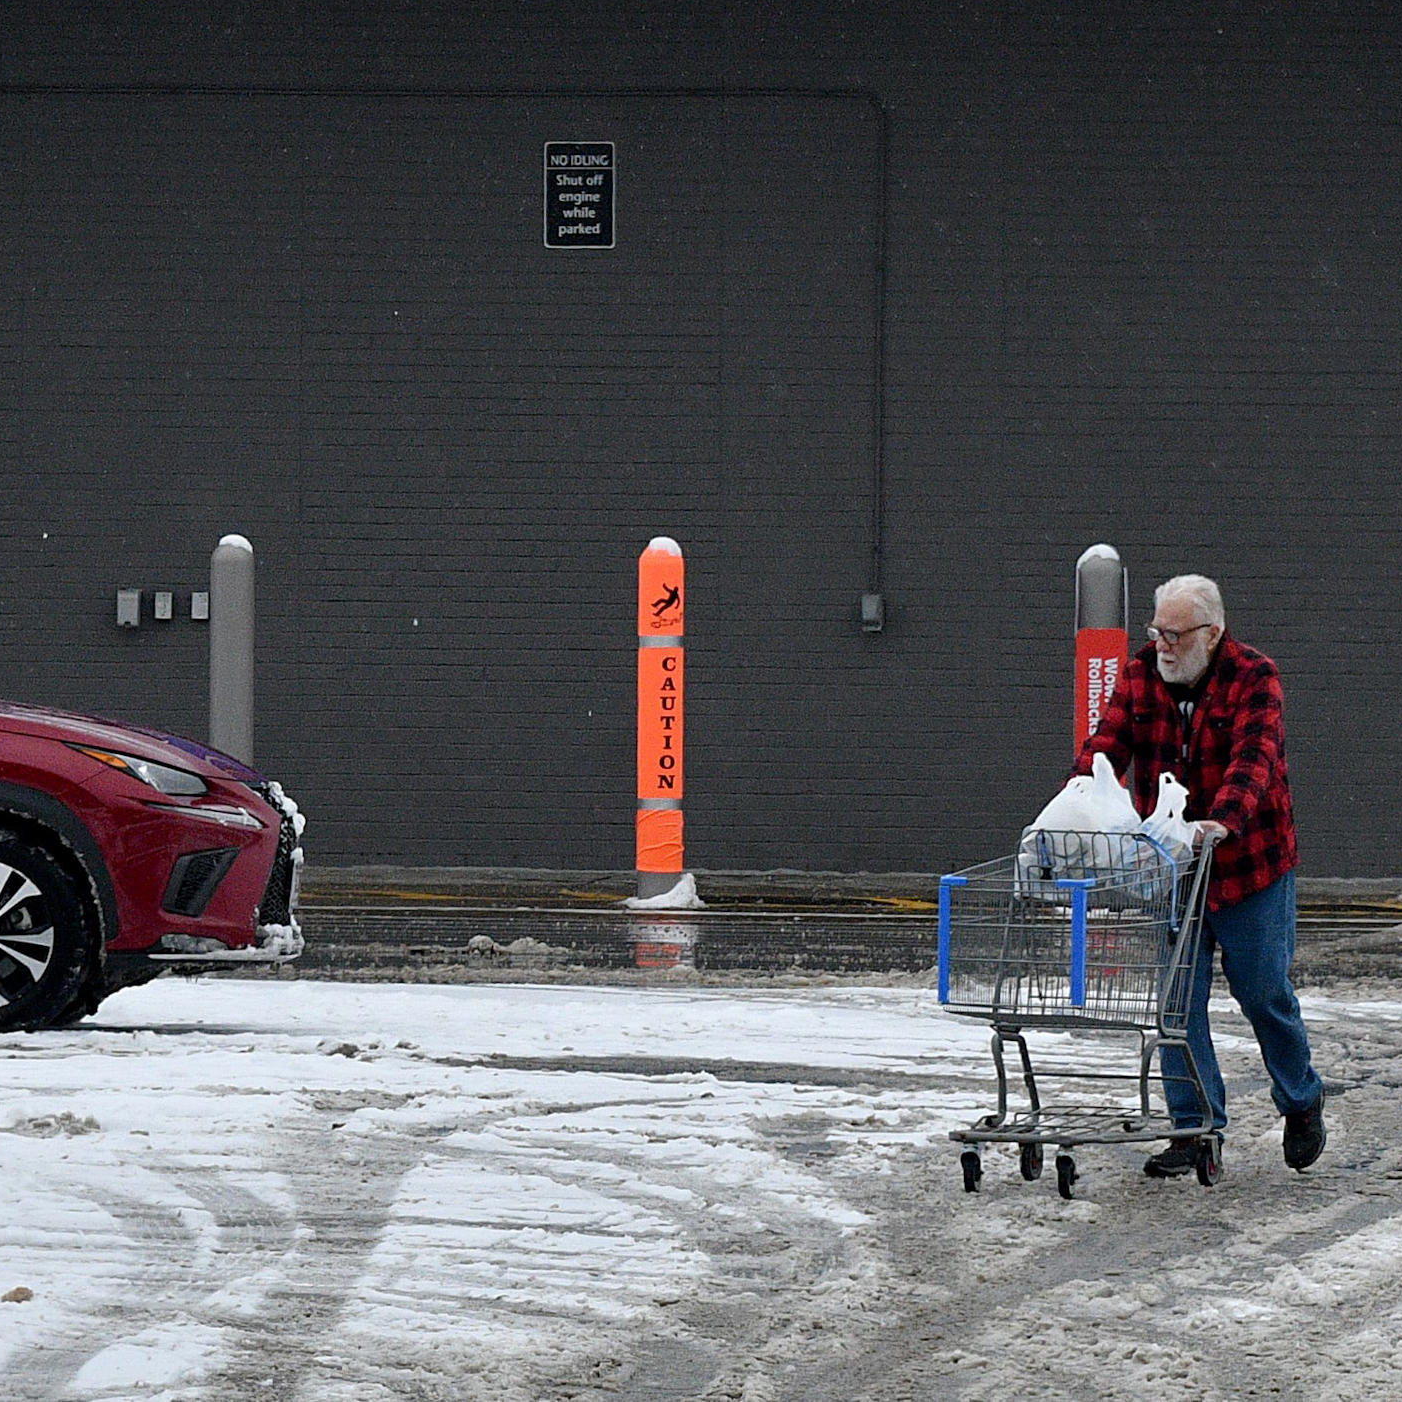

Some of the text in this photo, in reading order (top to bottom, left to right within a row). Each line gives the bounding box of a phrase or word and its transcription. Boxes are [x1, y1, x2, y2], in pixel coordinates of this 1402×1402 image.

[550, 154, 610, 166] NO IDLING
[556, 174, 604, 186] Shut off
[558, 191, 600, 205] engine
[562, 207, 596, 219] while
[558, 223, 600, 237] parked
[657, 656, 677, 789] CAUTION
